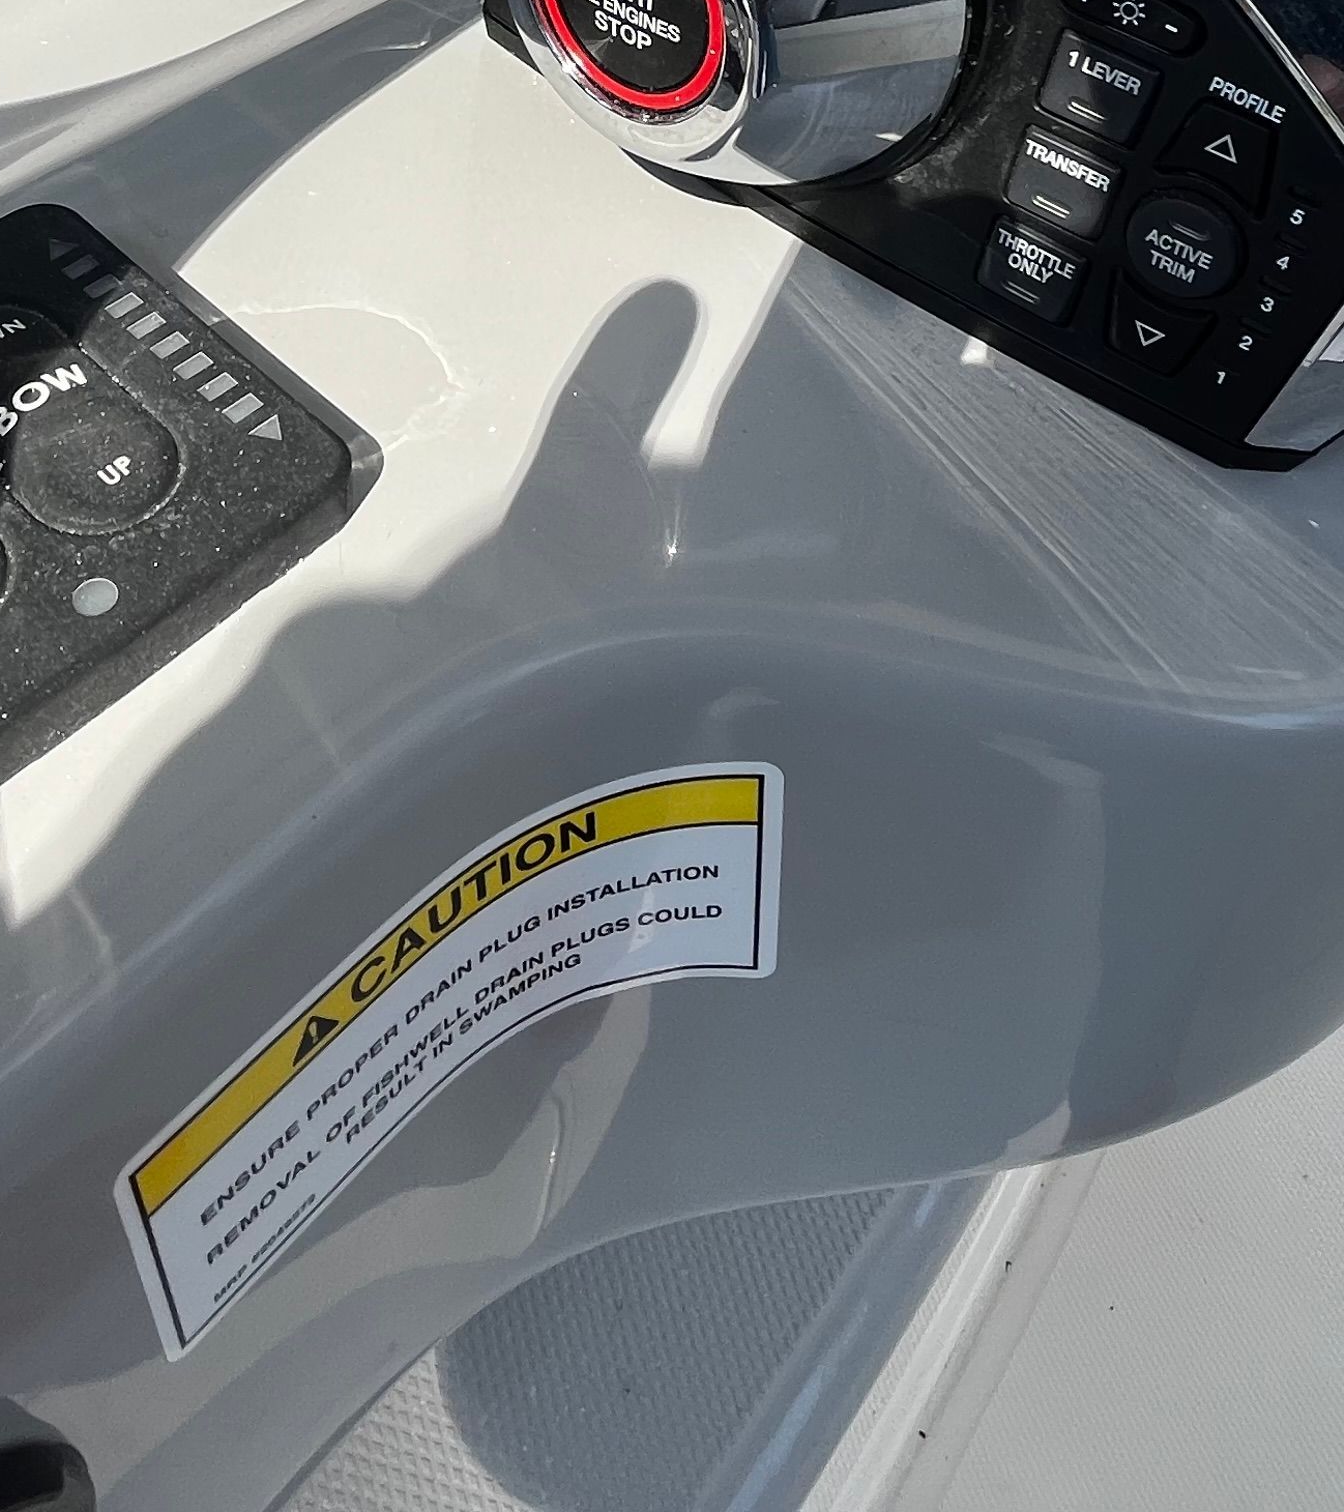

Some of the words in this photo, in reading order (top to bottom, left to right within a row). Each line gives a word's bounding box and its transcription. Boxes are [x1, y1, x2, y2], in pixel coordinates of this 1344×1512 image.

[594, 10, 652, 50] STOP
[1068, 51, 1080, 68] 1
[1081, 56, 1142, 96] LEVER
[1208, 77, 1287, 125] PROFILE
[1024, 138, 1111, 192] TRANSFER
[1289, 209, 1305, 226] 5
[997, 228, 1076, 280] THROTTLE
[1008, 254, 1054, 285] ONLY
[1144, 228, 1214, 270] ACTIVE
[1149, 249, 1196, 284] TRIM
[1275, 255, 1291, 271] 4
[1261, 297, 1274, 313] 3
[1239, 335, 1253, 351] 2
[1216, 370, 1227, 384] 1
[96, 455, 133, 486] UP
[349, 811, 598, 1003] CAUTION
[200, 1120, 299, 1226] ENSURE
[306, 1023, 400, 1122] PROPER
[405, 965, 473, 1019] DRAIN
[478, 915, 542, 963] PLUG
[547, 864, 720, 921] INSTALLATION
[343, 1059, 427, 1145] RESULT
[432, 1036, 454, 1060] IN
[459, 953, 582, 1036] SWAMPING
[206, 1149, 321, 1265] REMOVAL
[325, 1108, 358, 1143] OF
[361, 1006, 470, 1111] FISHWELL
[474, 949, 545, 1004] DRAIN
[550, 916, 631, 958] PLUGS
[637, 903, 723, 927] COULD
